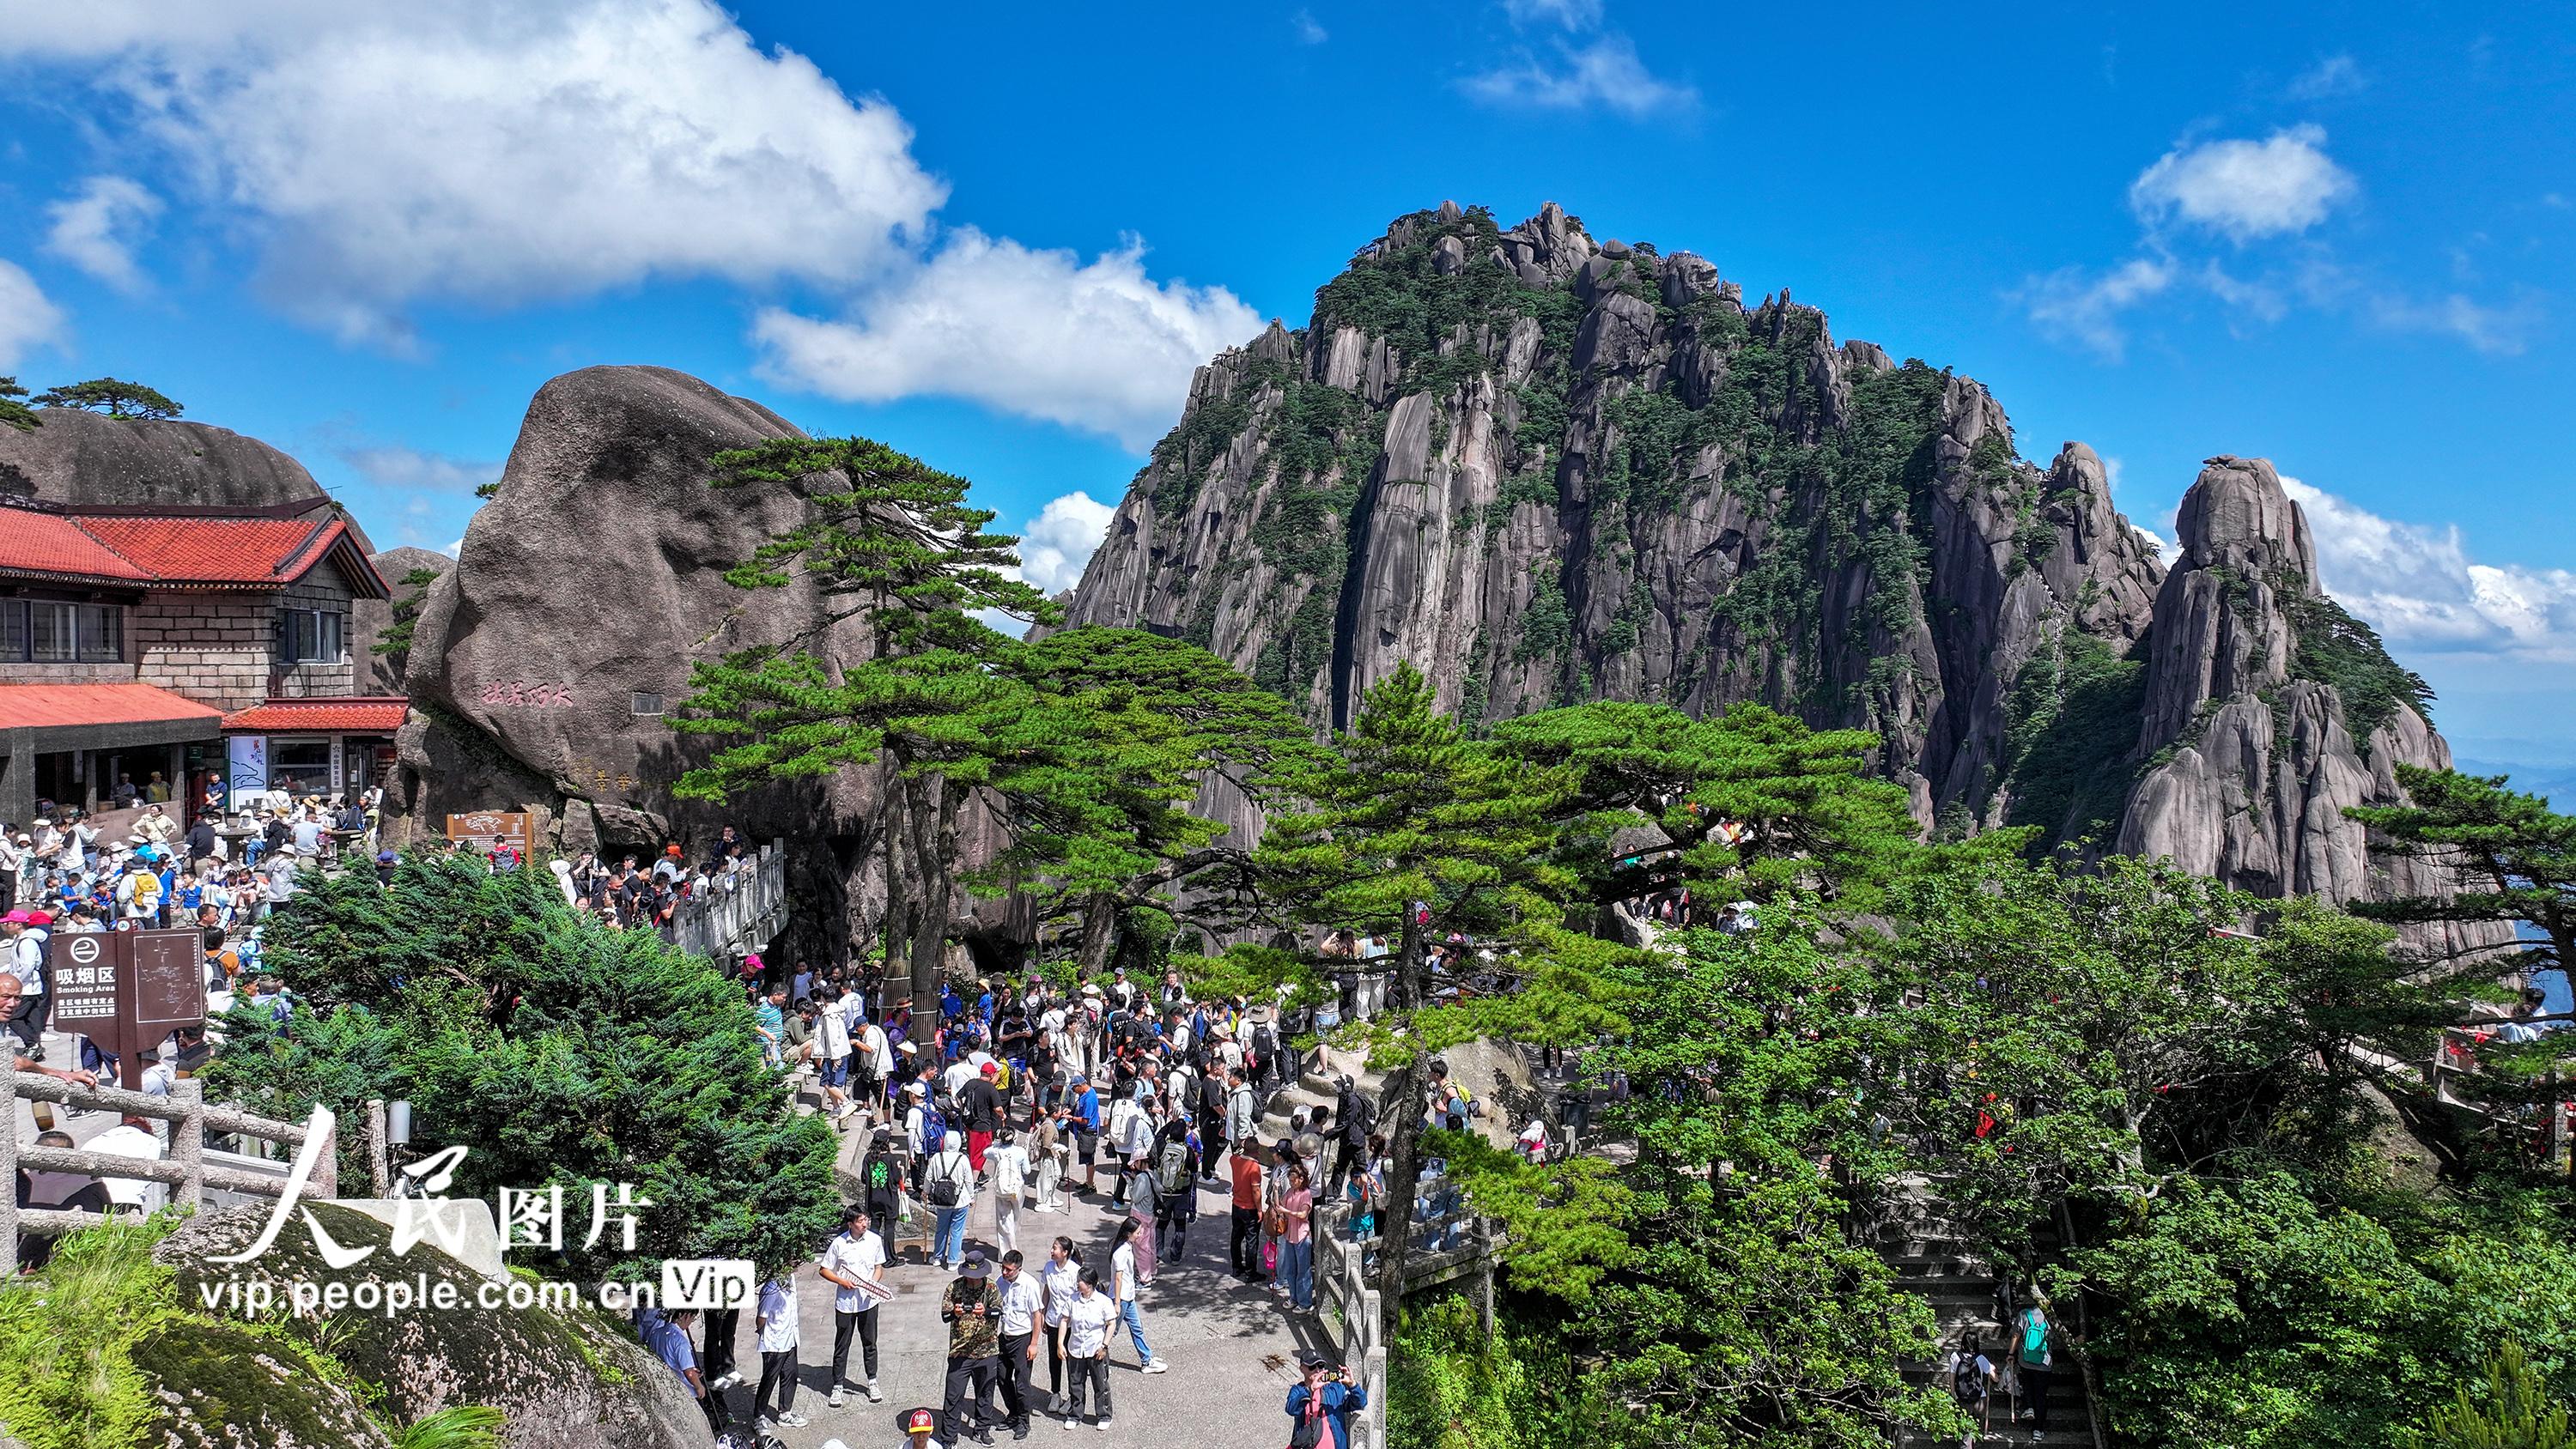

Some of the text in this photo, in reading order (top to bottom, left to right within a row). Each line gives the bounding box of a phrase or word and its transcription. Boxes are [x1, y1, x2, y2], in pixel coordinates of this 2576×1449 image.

[56, 967, 116, 985] 吸烟区
[58, 997, 115, 1005] 景区吸烟有定点
